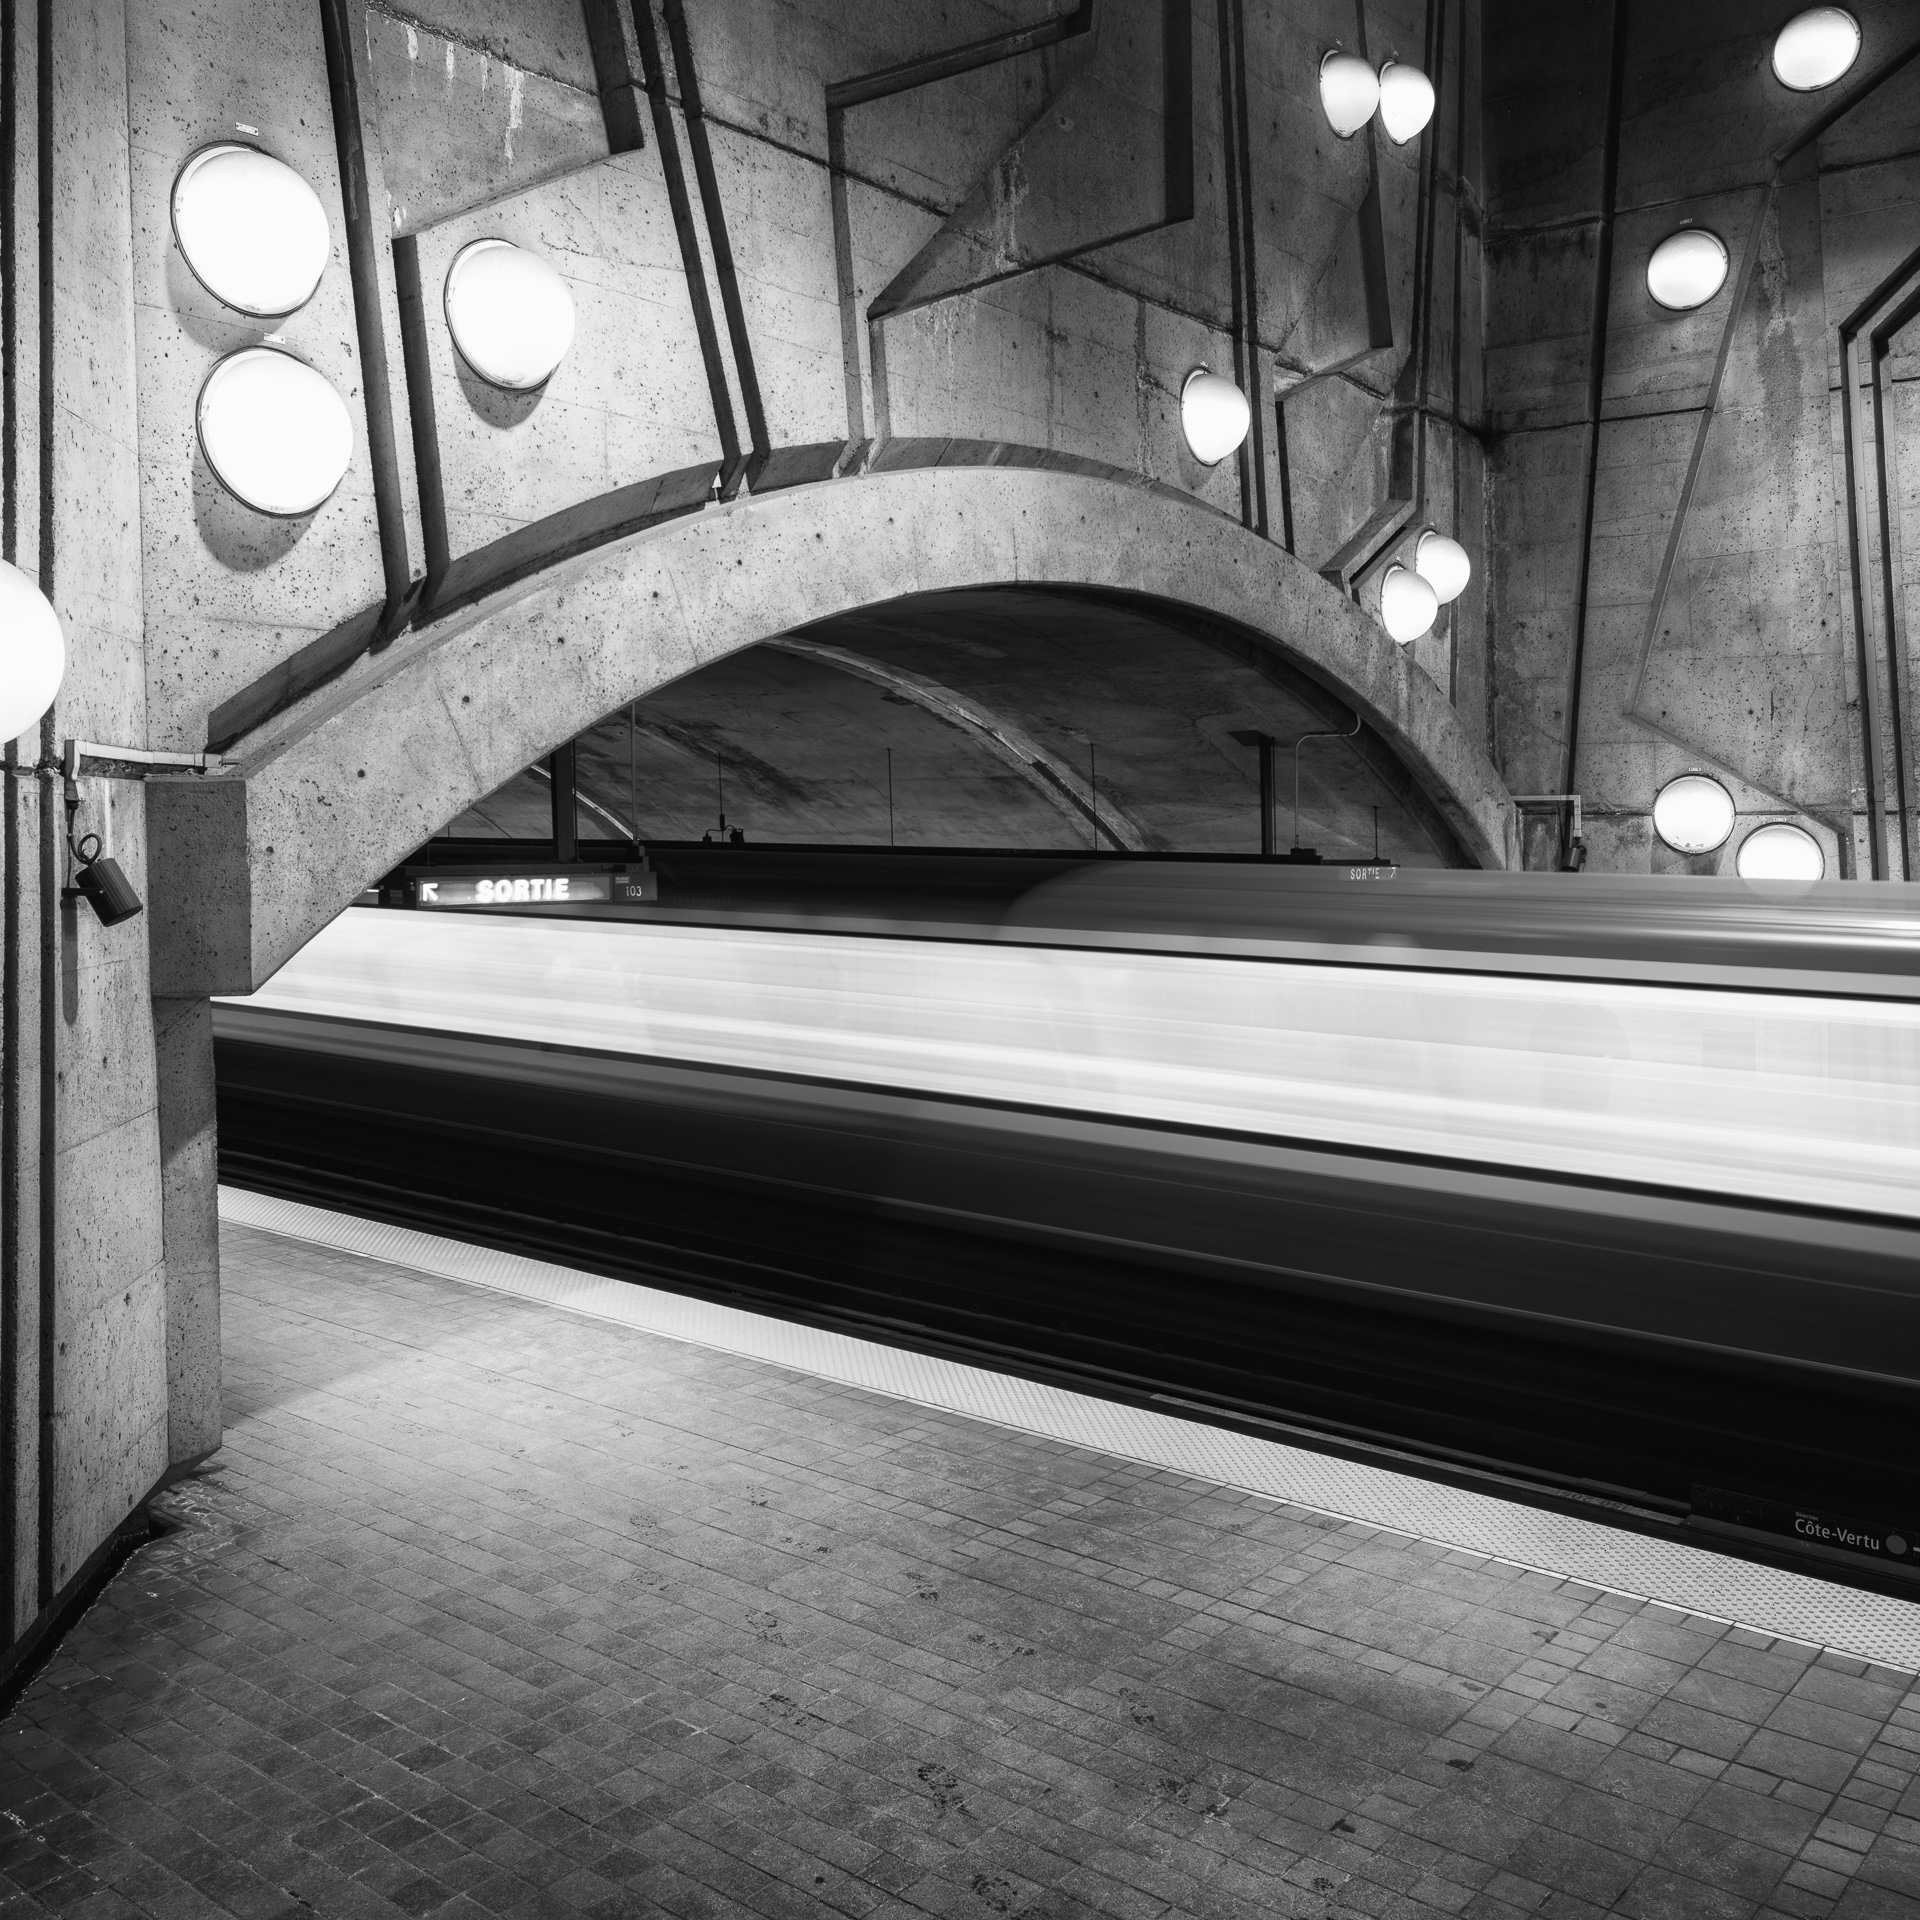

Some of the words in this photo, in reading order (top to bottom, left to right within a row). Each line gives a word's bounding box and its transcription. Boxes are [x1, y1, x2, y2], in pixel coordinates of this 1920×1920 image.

[1350, 868, 1379, 879] SORTIE
[475, 878, 569, 903] SORTIE
[626, 885, 642, 897] 103
[1795, 1511, 1819, 1521] Direction
[1795, 1518, 1880, 1550] Côte-Vertu
